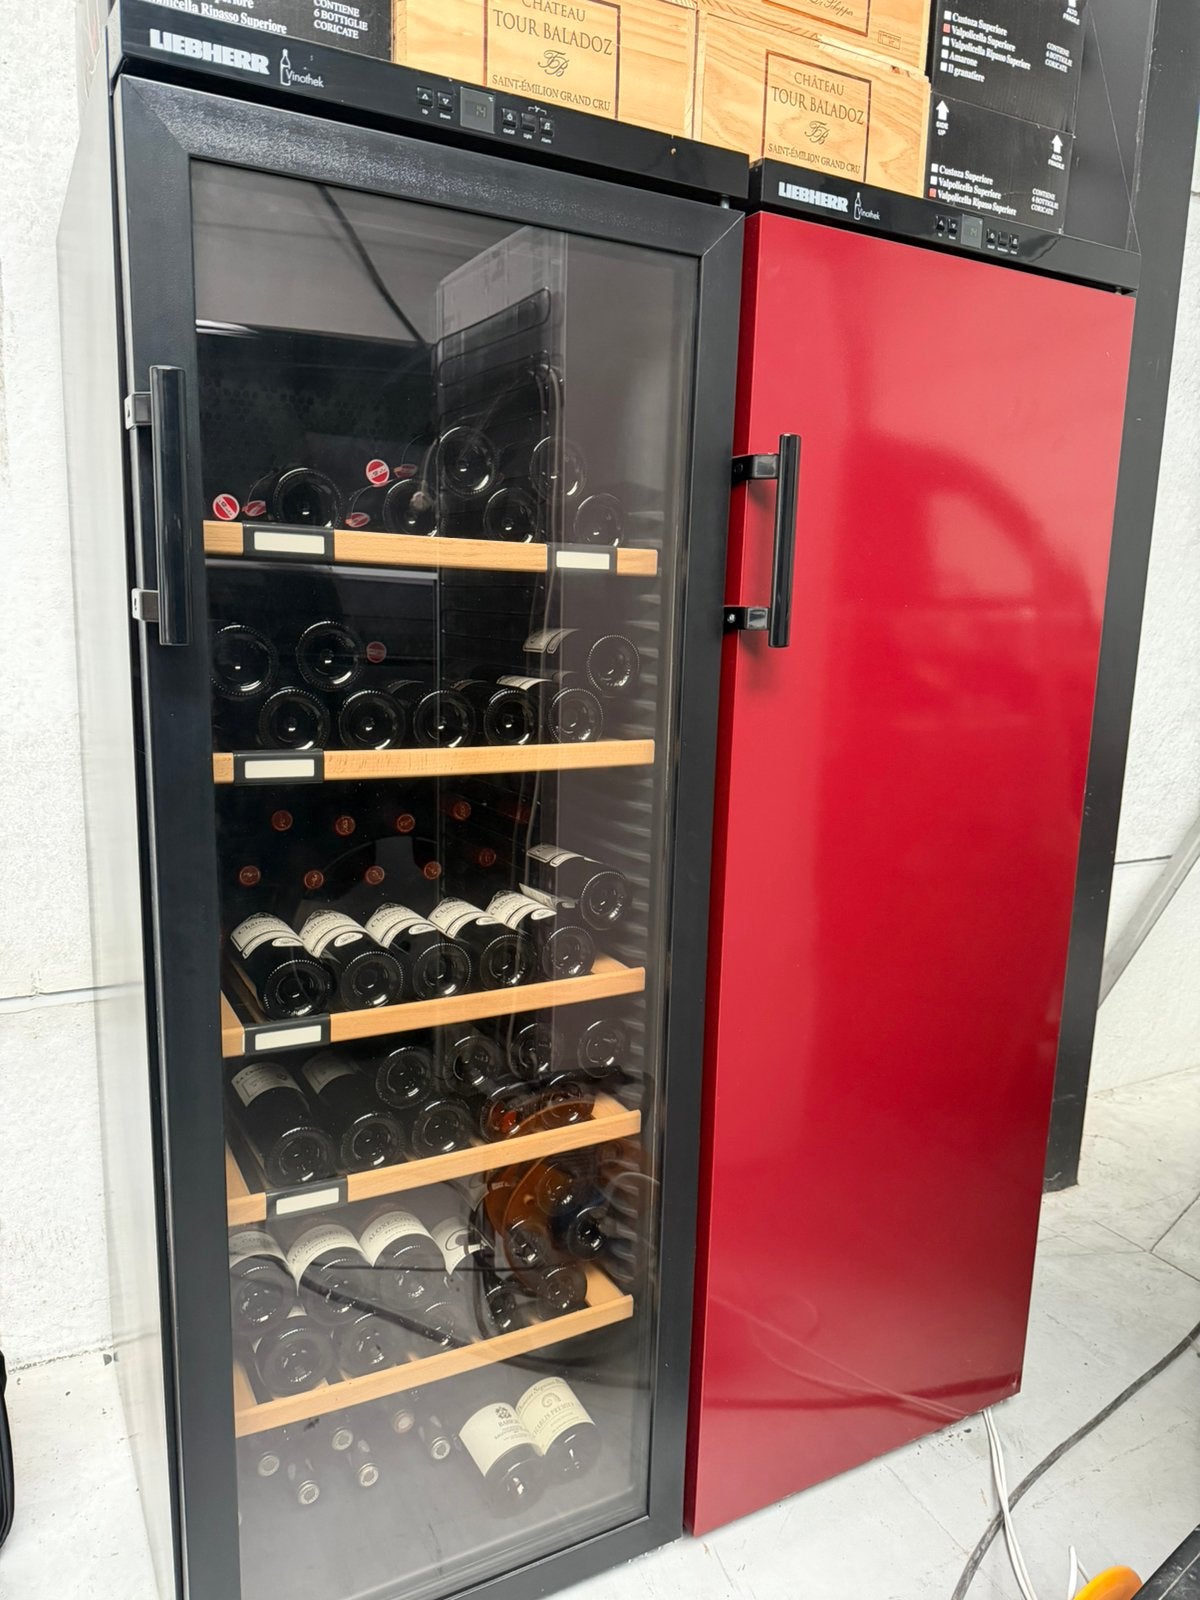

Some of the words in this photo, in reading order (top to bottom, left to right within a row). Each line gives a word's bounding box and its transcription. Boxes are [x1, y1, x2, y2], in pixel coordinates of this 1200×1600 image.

[200, 2, 239, 23] Ripasso
[240, 12, 288, 34] Superiore
[313, 0, 360, 17] CONTIENE
[313, 8, 321, 17] 6
[321, 10, 369, 31] BOTTIGLIE
[313, 19, 359, 39] CORICATE
[492, 9, 539, 37] TOUR
[543, 22, 613, 56] BALADOZ
[952, 26, 987, 43] Valpolicella
[987, 35, 1017, 52] Superiore
[978, 19, 1008, 36] Superiore
[149, 28, 270, 75] LIEBHERR
[949, 51, 978, 67] Amarone
[951, 38, 986, 56] Valpolicella
[986, 48, 1006, 63] Ripasso
[1006, 55, 1031, 70] Superiore
[284, 70, 325, 88] Vinothek
[492, 74, 559, 98] SAINT-ÉMILION
[560, 90, 592, 107] GRAND
[592, 98, 611, 112] CRU
[771, 86, 807, 111] TOUR
[810, 96, 865, 125] BALADOZ
[768, 143, 821, 164] SAINT-ÉMILION
[821, 156, 846, 171] GRAND
[846, 163, 861, 174] CRU
[938, 177, 973, 194] Valpolicella
[974, 185, 1002, 200] Superiore
[965, 170, 994, 185] Superiore
[778, 181, 849, 213] LIEBHERR
[938, 189, 972, 206] Valpolicella
[972, 197, 992, 211] Ripasso
[992, 201, 1017, 216] Superiore
